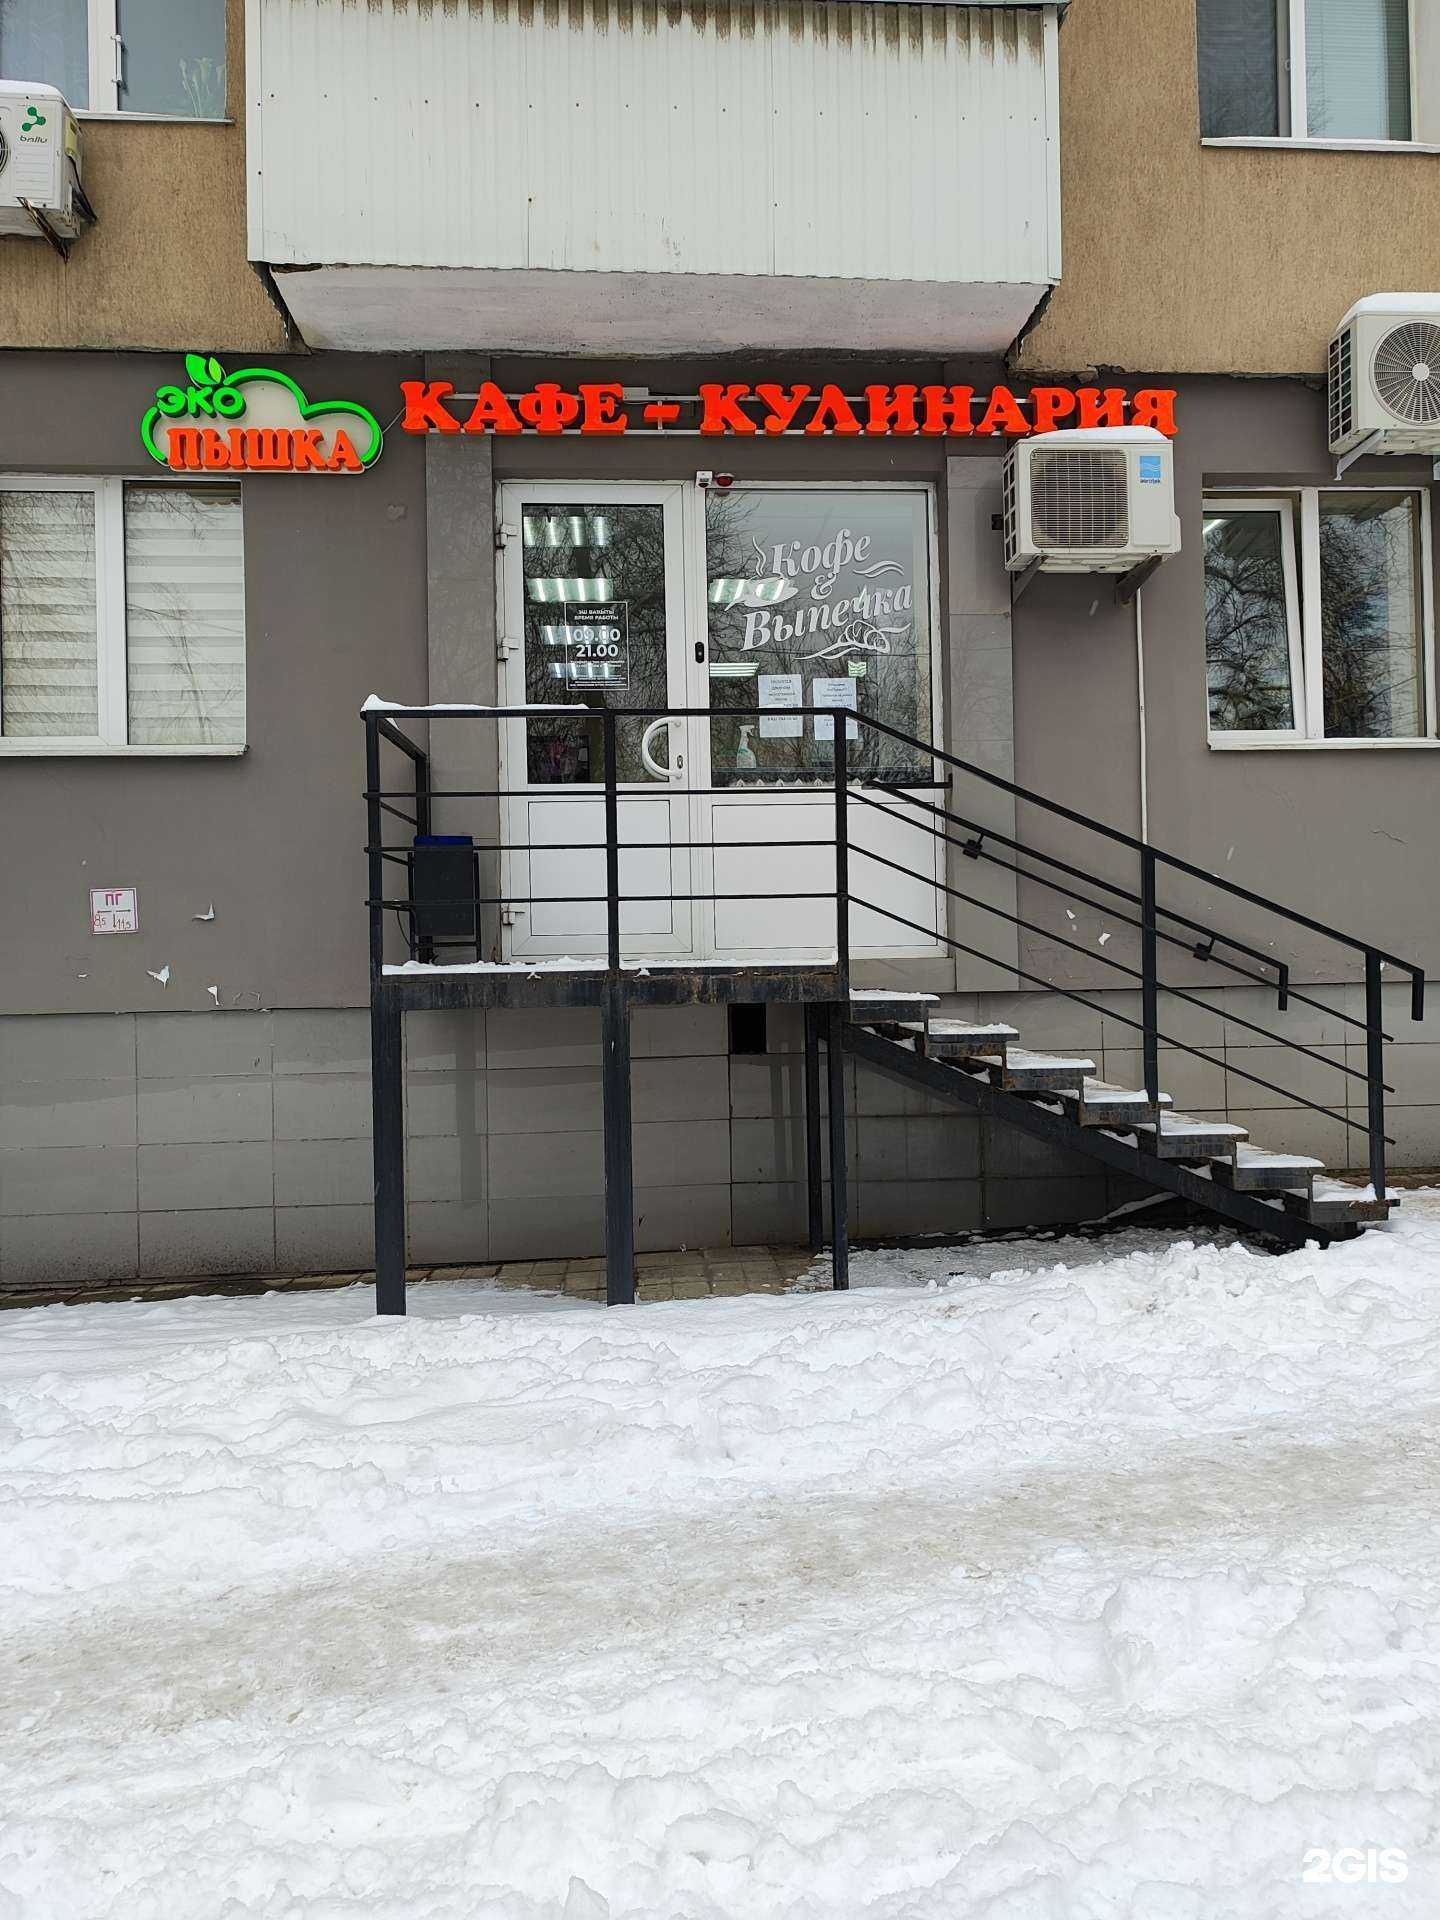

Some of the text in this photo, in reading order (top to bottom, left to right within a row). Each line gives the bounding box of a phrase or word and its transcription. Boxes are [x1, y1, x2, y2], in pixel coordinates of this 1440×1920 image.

[156, 385, 246, 418] ЭКО
[400, 381, 627, 435] КАФЕ
[699, 384, 1178, 436] КУЛИНАРИЯ
[166, 428, 363, 471] ПЫШКА
[771, 528, 871, 577] Кофе
[810, 573, 836, 600] &
[740, 585, 912, 651] Выпечка
[575, 644, 619, 658] 21.00
[105, 893, 122, 906] ПГ
